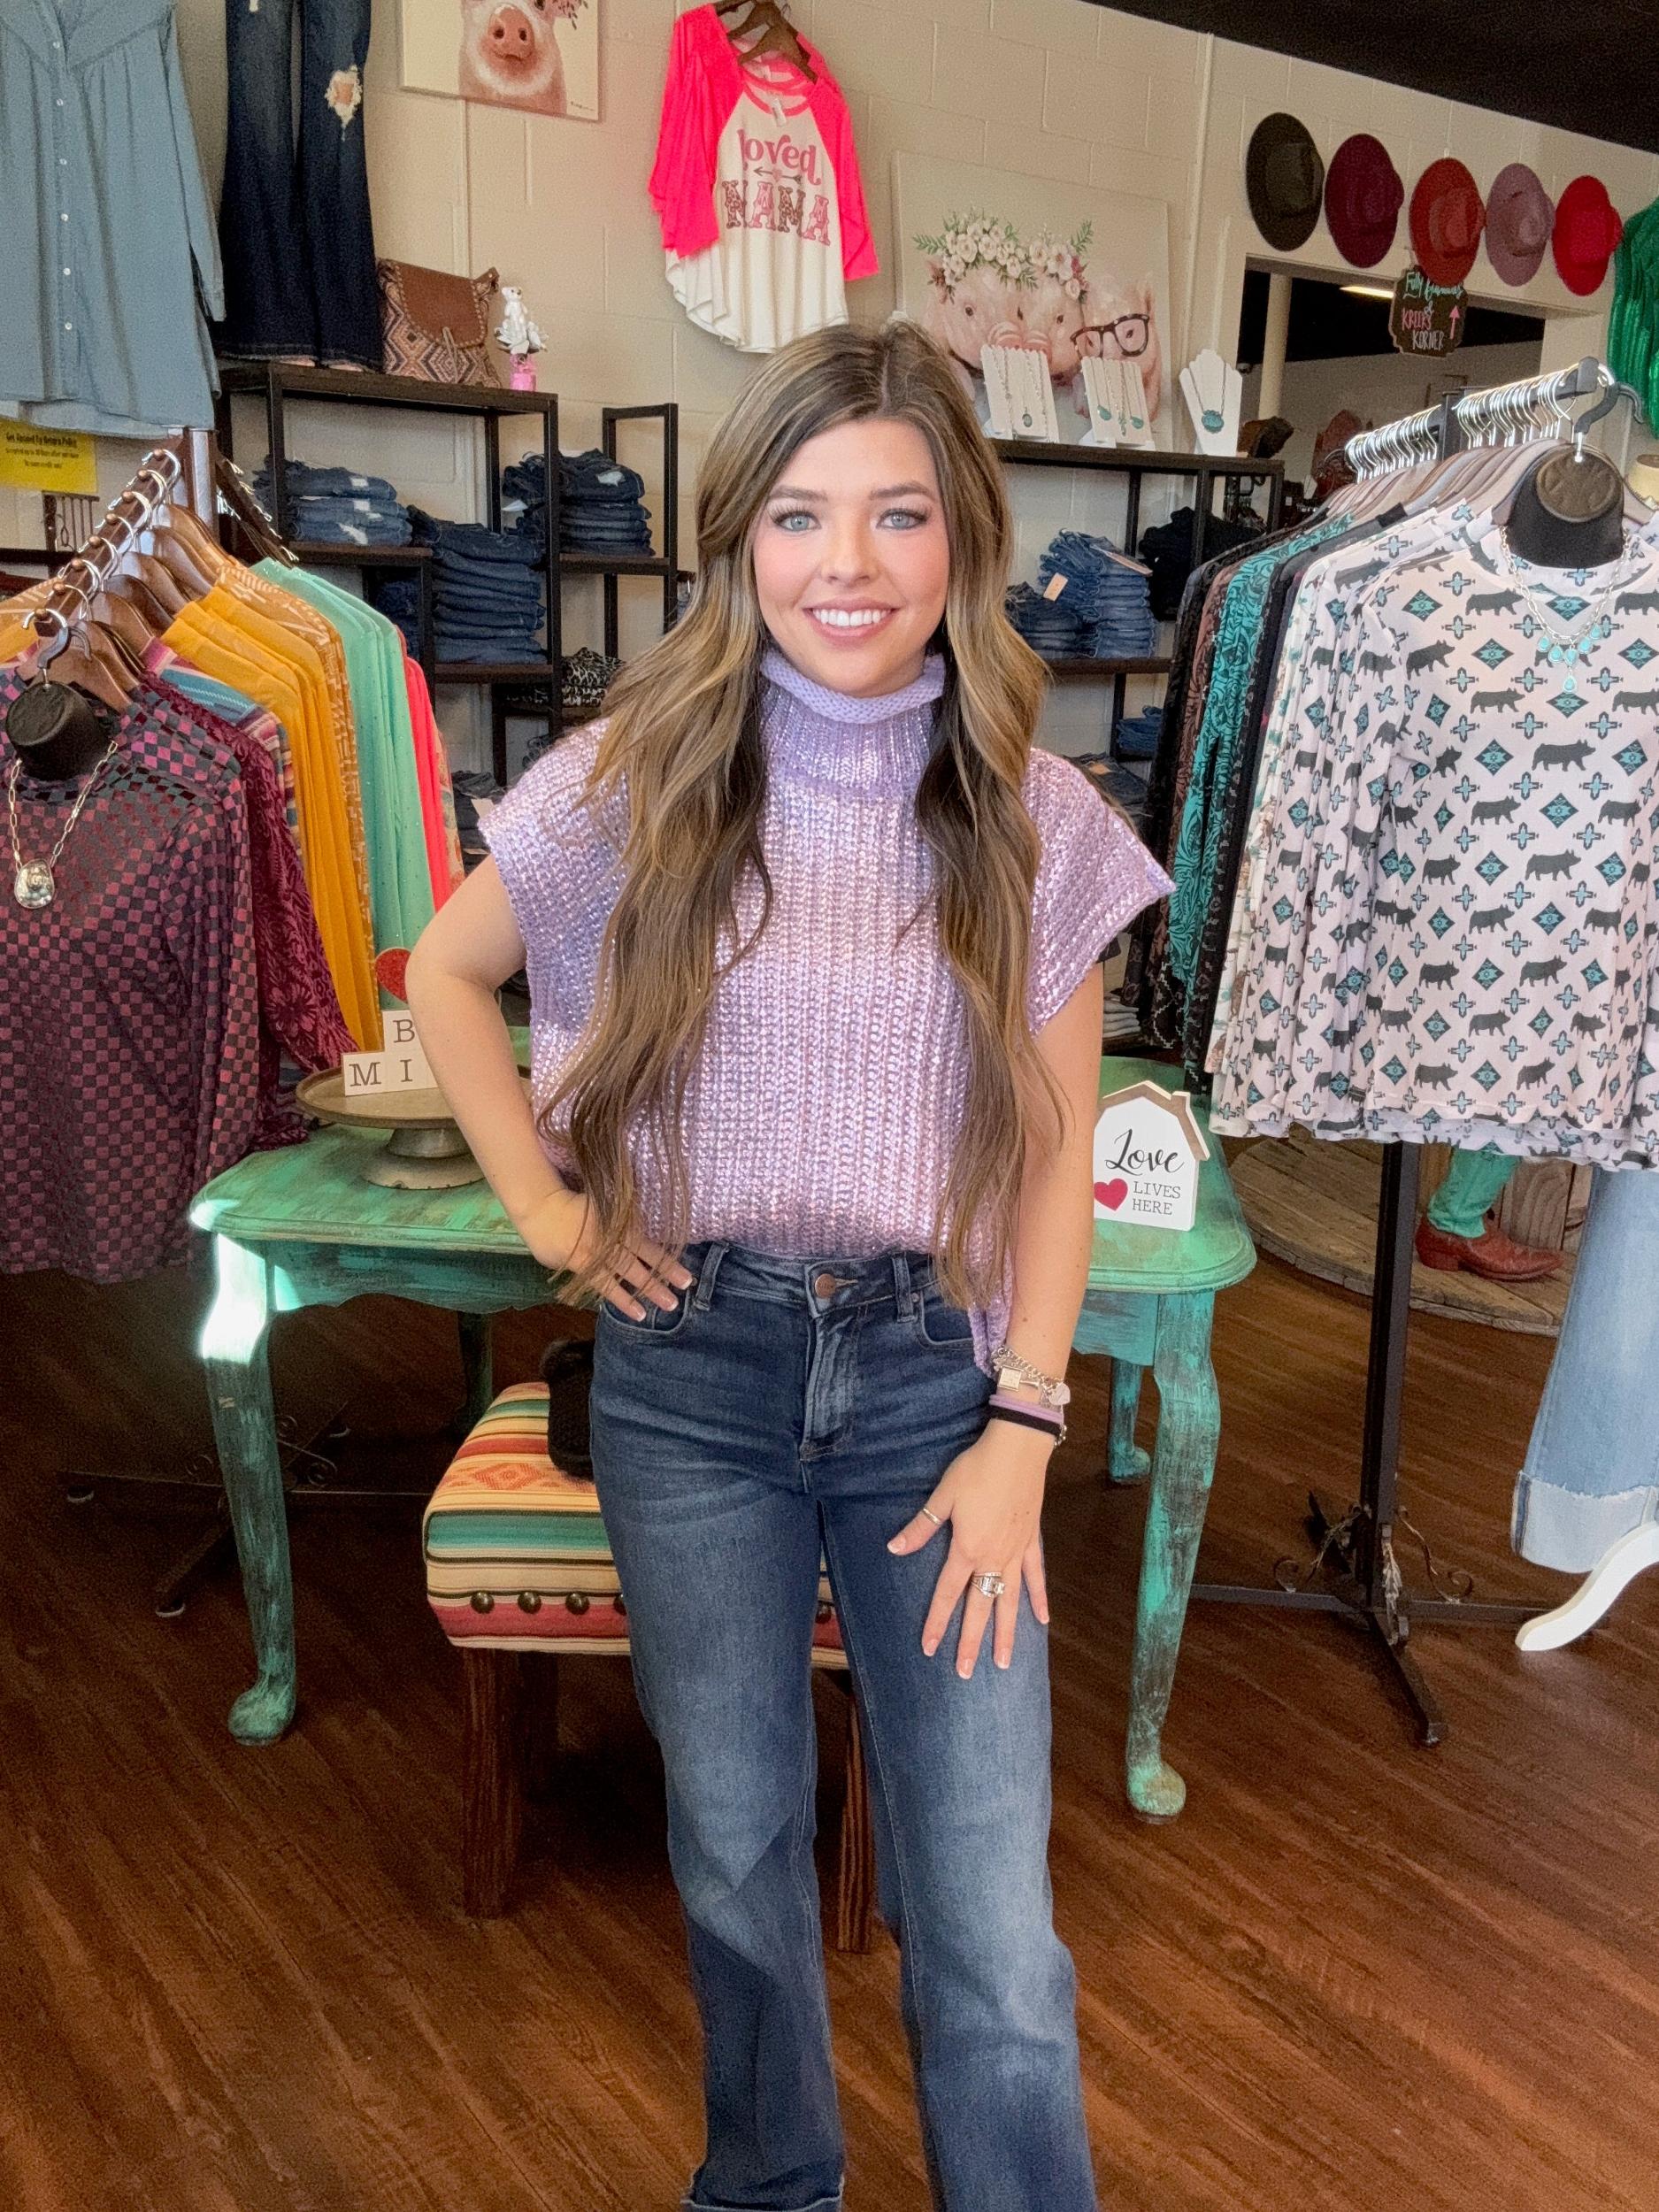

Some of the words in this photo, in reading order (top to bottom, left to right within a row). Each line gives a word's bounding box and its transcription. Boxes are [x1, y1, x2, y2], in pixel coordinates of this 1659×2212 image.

[738, 129, 821, 186] loved
[722, 180, 831, 246] NANA
[1412, 329, 1444, 350] KORNER
[1104, 1129, 1185, 1176] Love
[1133, 1181, 1181, 1200] LIVES
[1133, 1198, 1173, 1216] HERE
